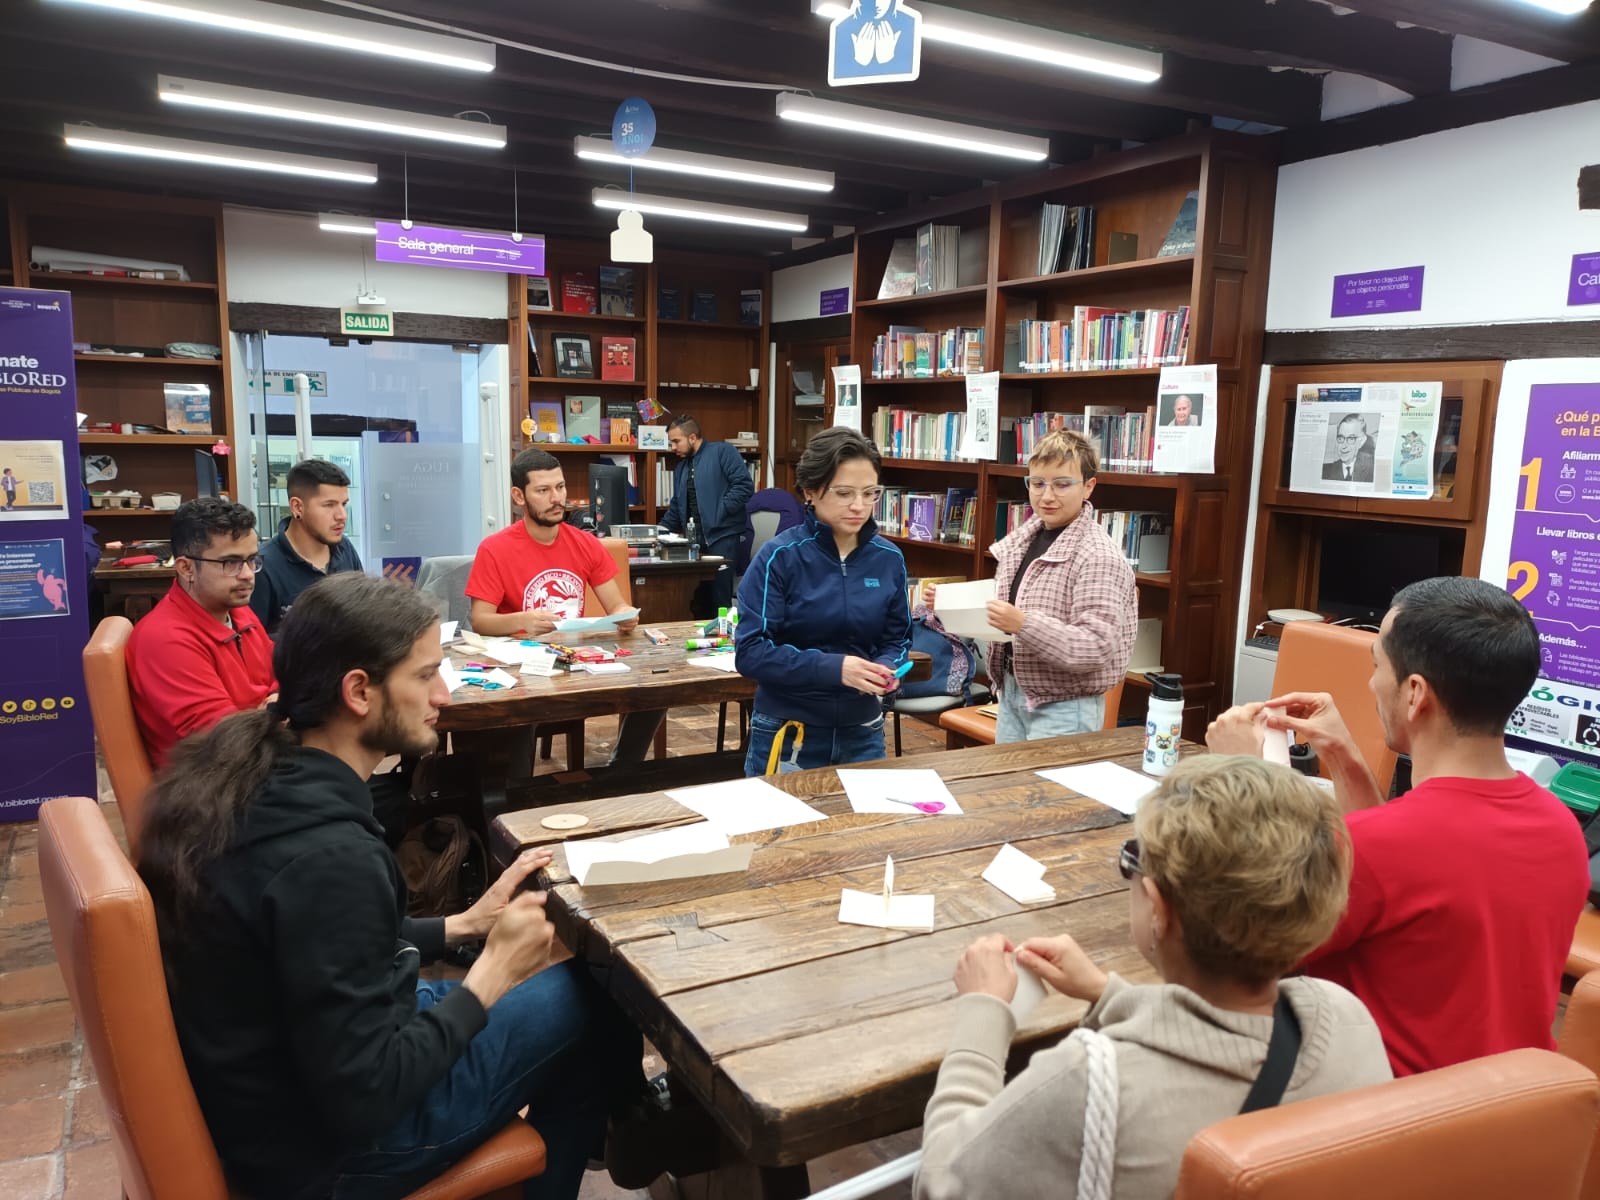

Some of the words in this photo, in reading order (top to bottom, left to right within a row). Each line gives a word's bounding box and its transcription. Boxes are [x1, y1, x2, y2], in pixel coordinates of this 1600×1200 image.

[621, 122, 634, 137] 35
[398, 236, 426, 250] Sala
[429, 243, 474, 255] general
[1578, 272, 1600, 286] Ca
[346, 315, 388, 329] SALIDA
[1555, 410, 1589, 425] ¿Qué
[1561, 427, 1577, 437] en
[1580, 425, 1590, 437] la
[1520, 457, 1542, 512] 1
[1536, 526, 1565, 538] Llevar
[1567, 529, 1595, 540] libros
